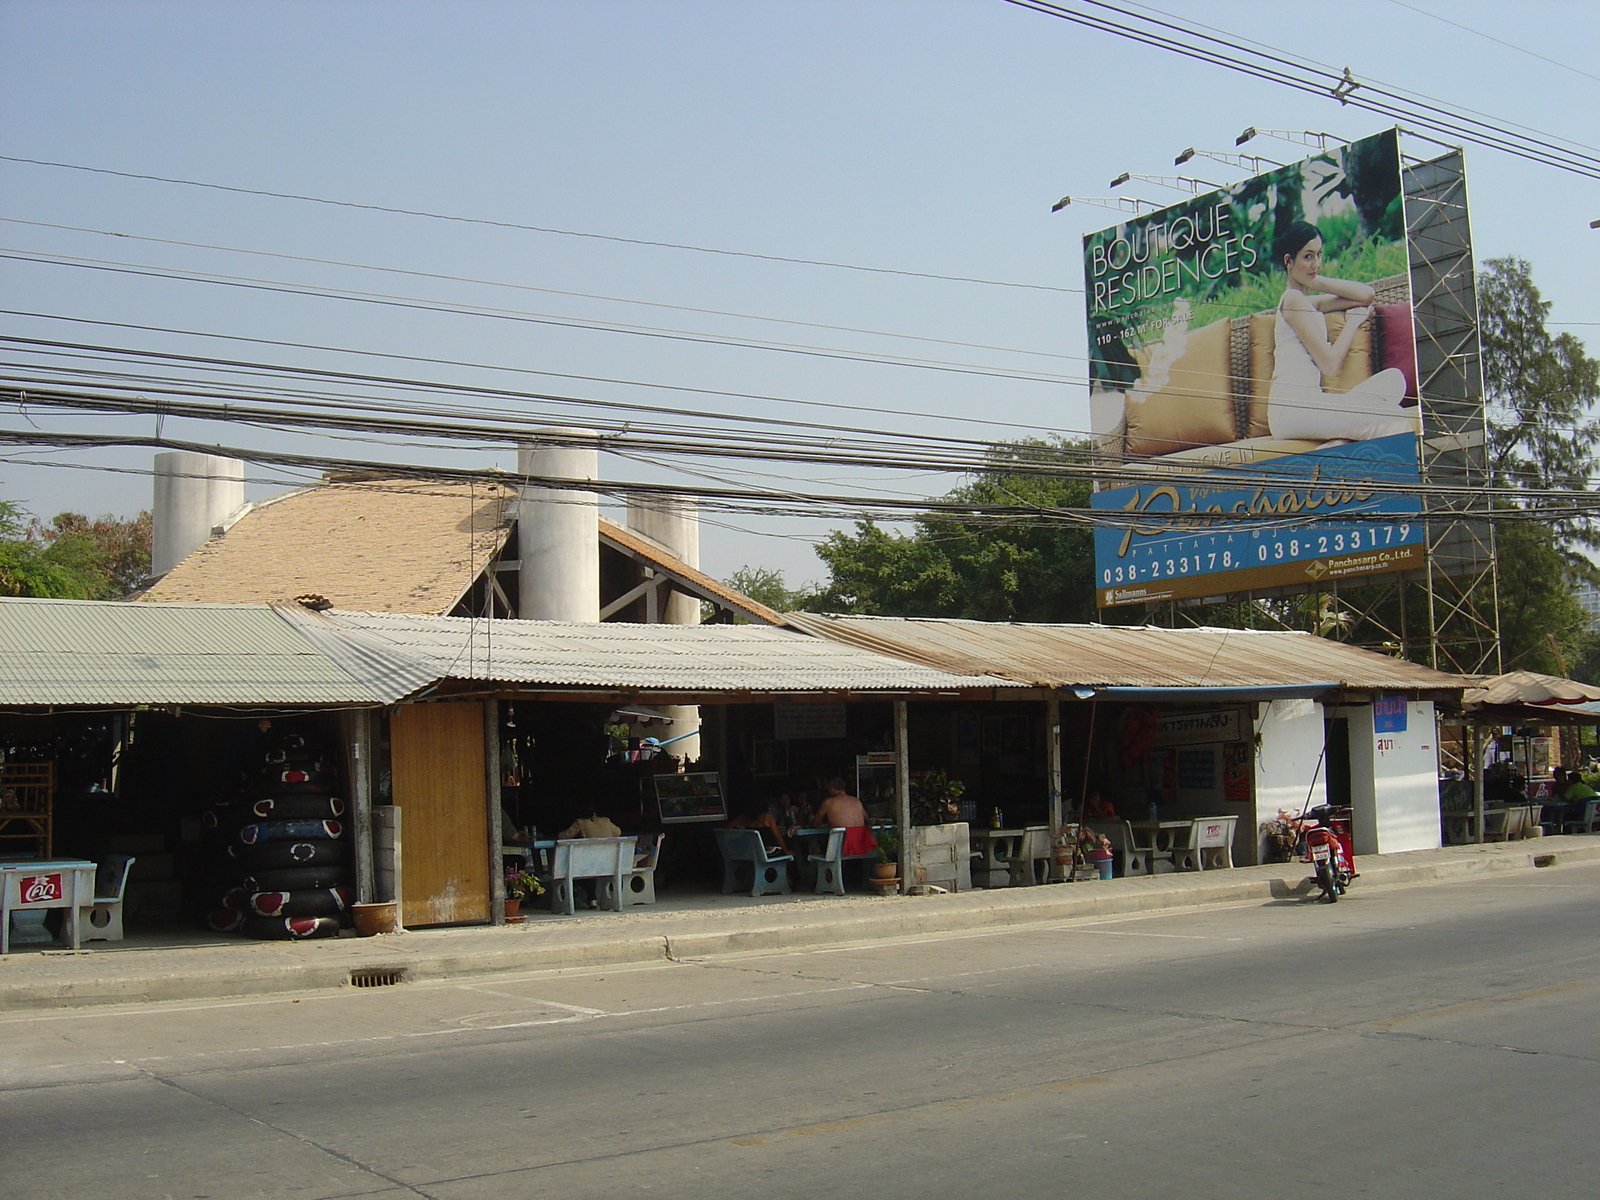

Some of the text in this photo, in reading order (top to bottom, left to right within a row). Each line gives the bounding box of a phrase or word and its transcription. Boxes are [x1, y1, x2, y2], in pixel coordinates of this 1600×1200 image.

[1093, 202, 1230, 278] BOUTIQUE
[1095, 233, 1257, 314] RESIDENCES
[1096, 333, 1112, 346] 110
[1119, 326, 1135, 339] 162
[1150, 317, 1170, 331] FOR
[1171, 309, 1195, 326] SALE
[1238, 445, 1255, 464] IN
[1103, 550, 1240, 584] 038-233178,
[1258, 523, 1410, 562] 038-233179
[1132, 534, 1233, 557] PATTAYA
[1328, 555, 1377, 569] Panchasarp
[1329, 562, 1389, 576] www.panchasarp.co.th
[1377, 738, 1394, 757] สุขา
